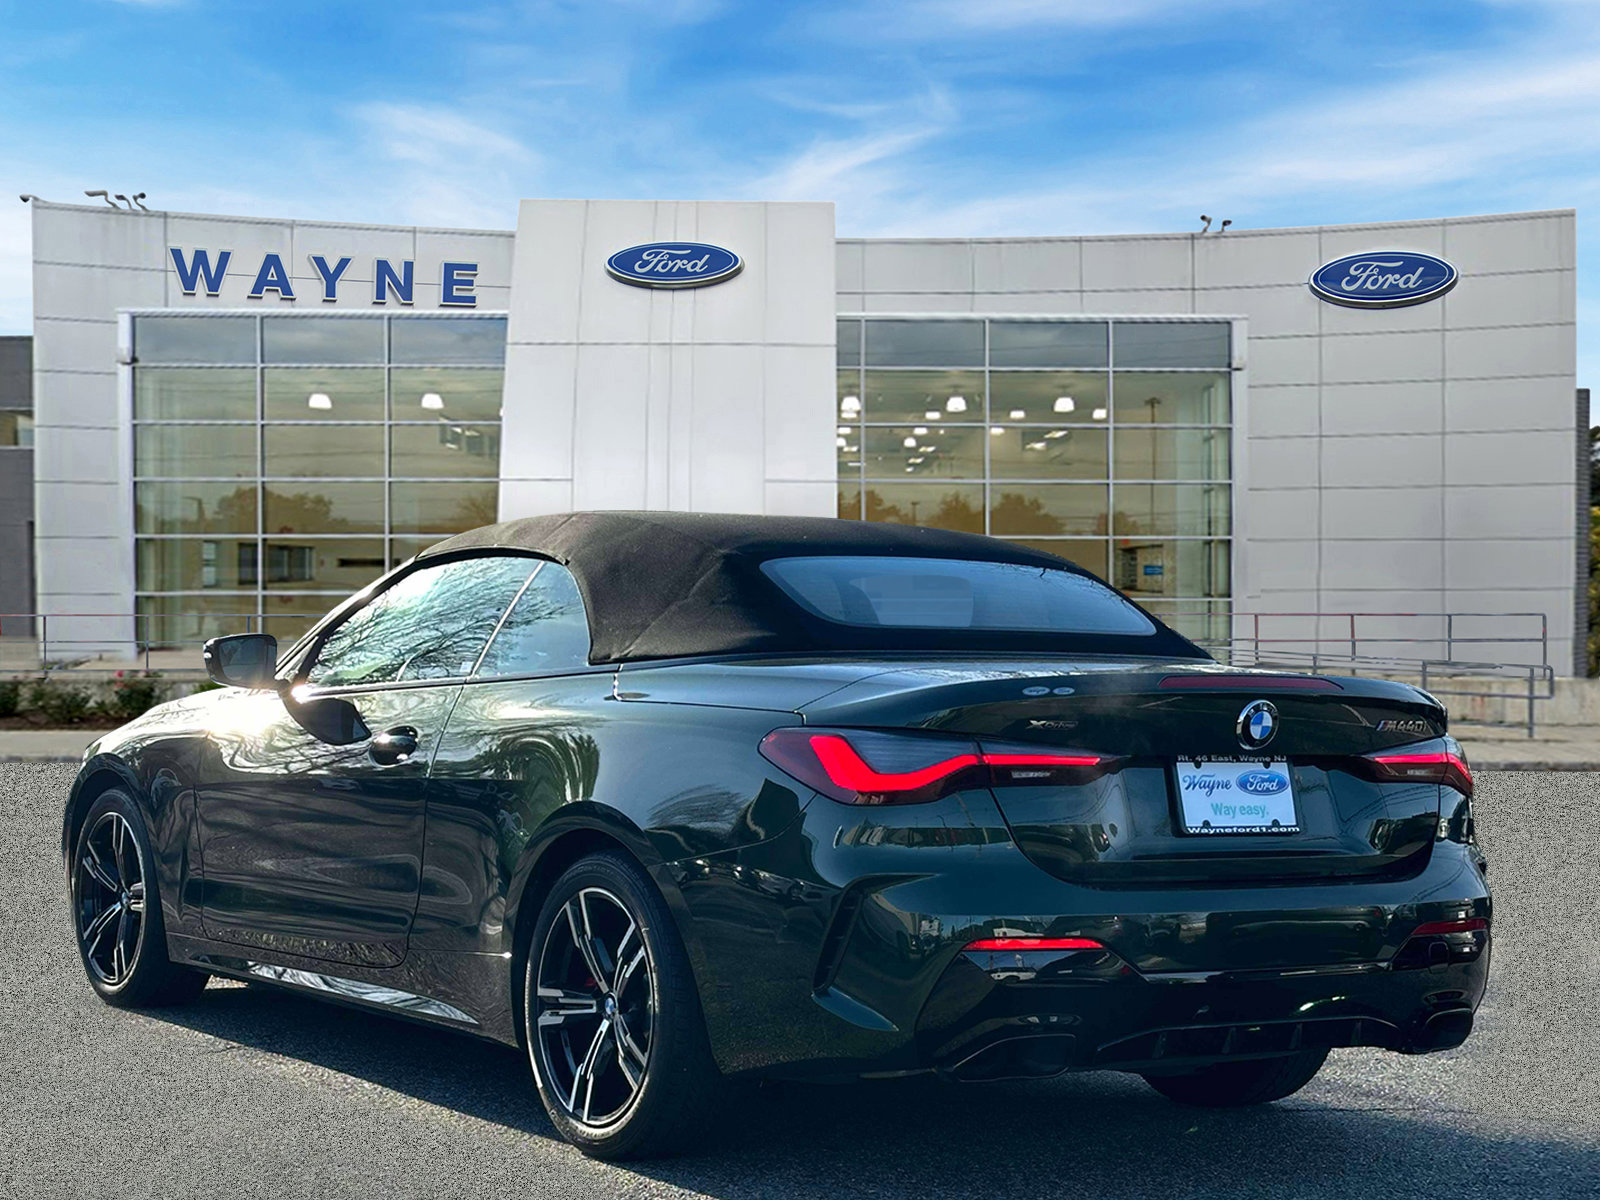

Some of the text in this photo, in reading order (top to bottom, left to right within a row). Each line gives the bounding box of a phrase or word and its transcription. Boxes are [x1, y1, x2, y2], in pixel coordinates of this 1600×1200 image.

[634, 248, 711, 273] Ford
[169, 246, 480, 307] WAYNE
[1340, 261, 1425, 291] Ford
[1238, 755, 1271, 763] Wayne
[1274, 754, 1287, 762] NJ
[1182, 774, 1279, 798] Wayne Ford
[1210, 803, 1270, 819] Way easy.
